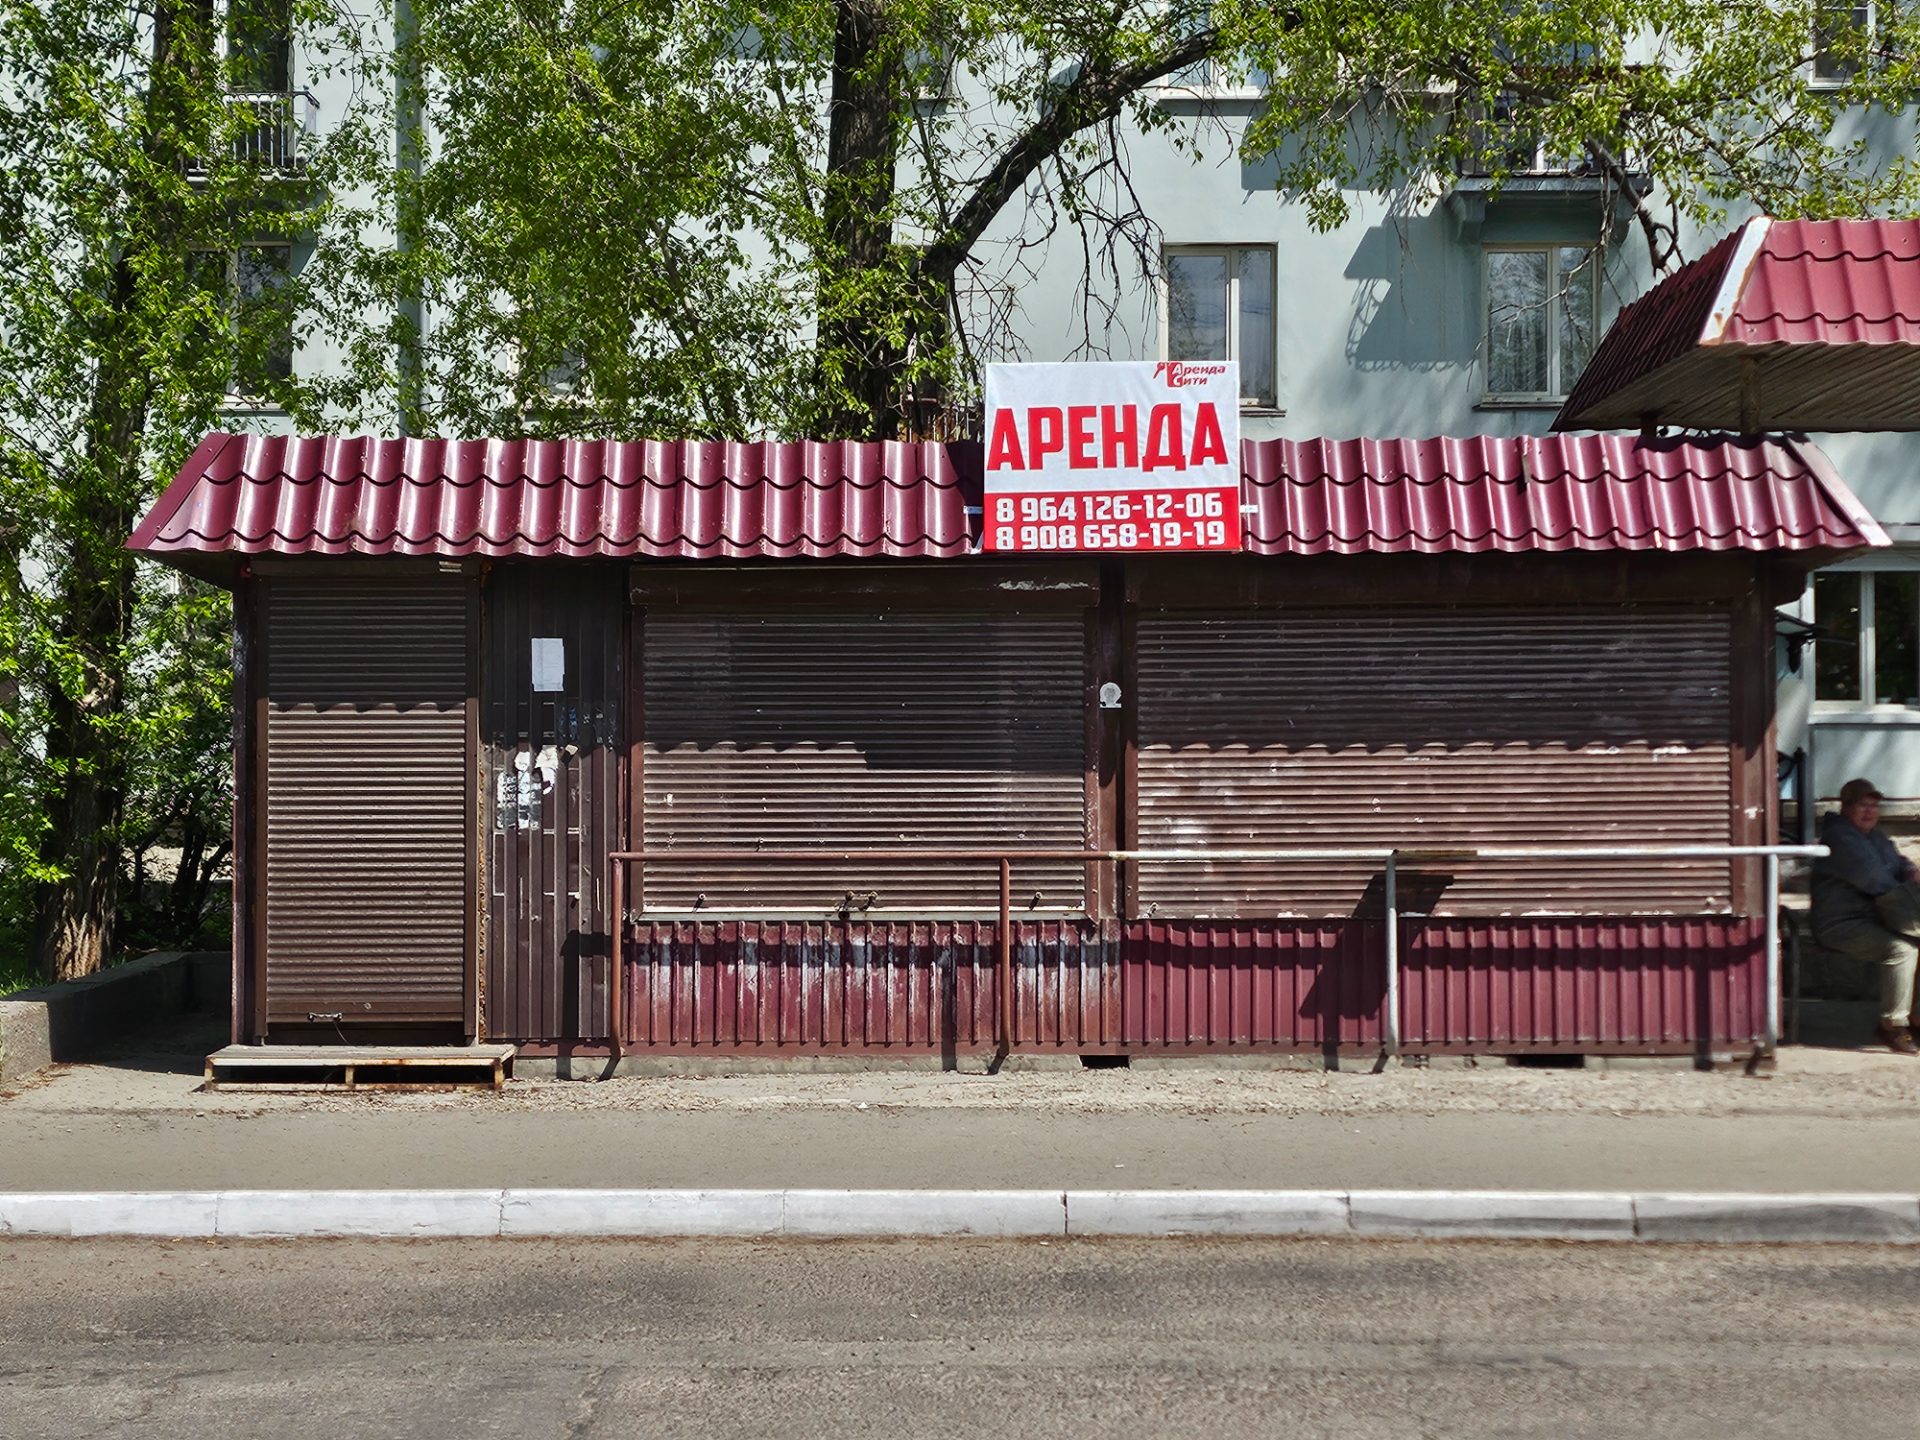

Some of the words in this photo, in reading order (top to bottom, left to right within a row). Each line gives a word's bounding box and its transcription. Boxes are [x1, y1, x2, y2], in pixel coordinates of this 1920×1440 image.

[1172, 363, 1226, 376] Аренда
[1173, 375, 1208, 386] Сити
[987, 402, 1228, 472] АРЕНДА
[996, 497, 1015, 522] 8
[1021, 496, 1077, 521] 964
[1082, 492, 1223, 520] 126-12-06
[996, 526, 1014, 550] 8
[1020, 524, 1077, 550] 908
[1083, 520, 1225, 549] 658-19-19
